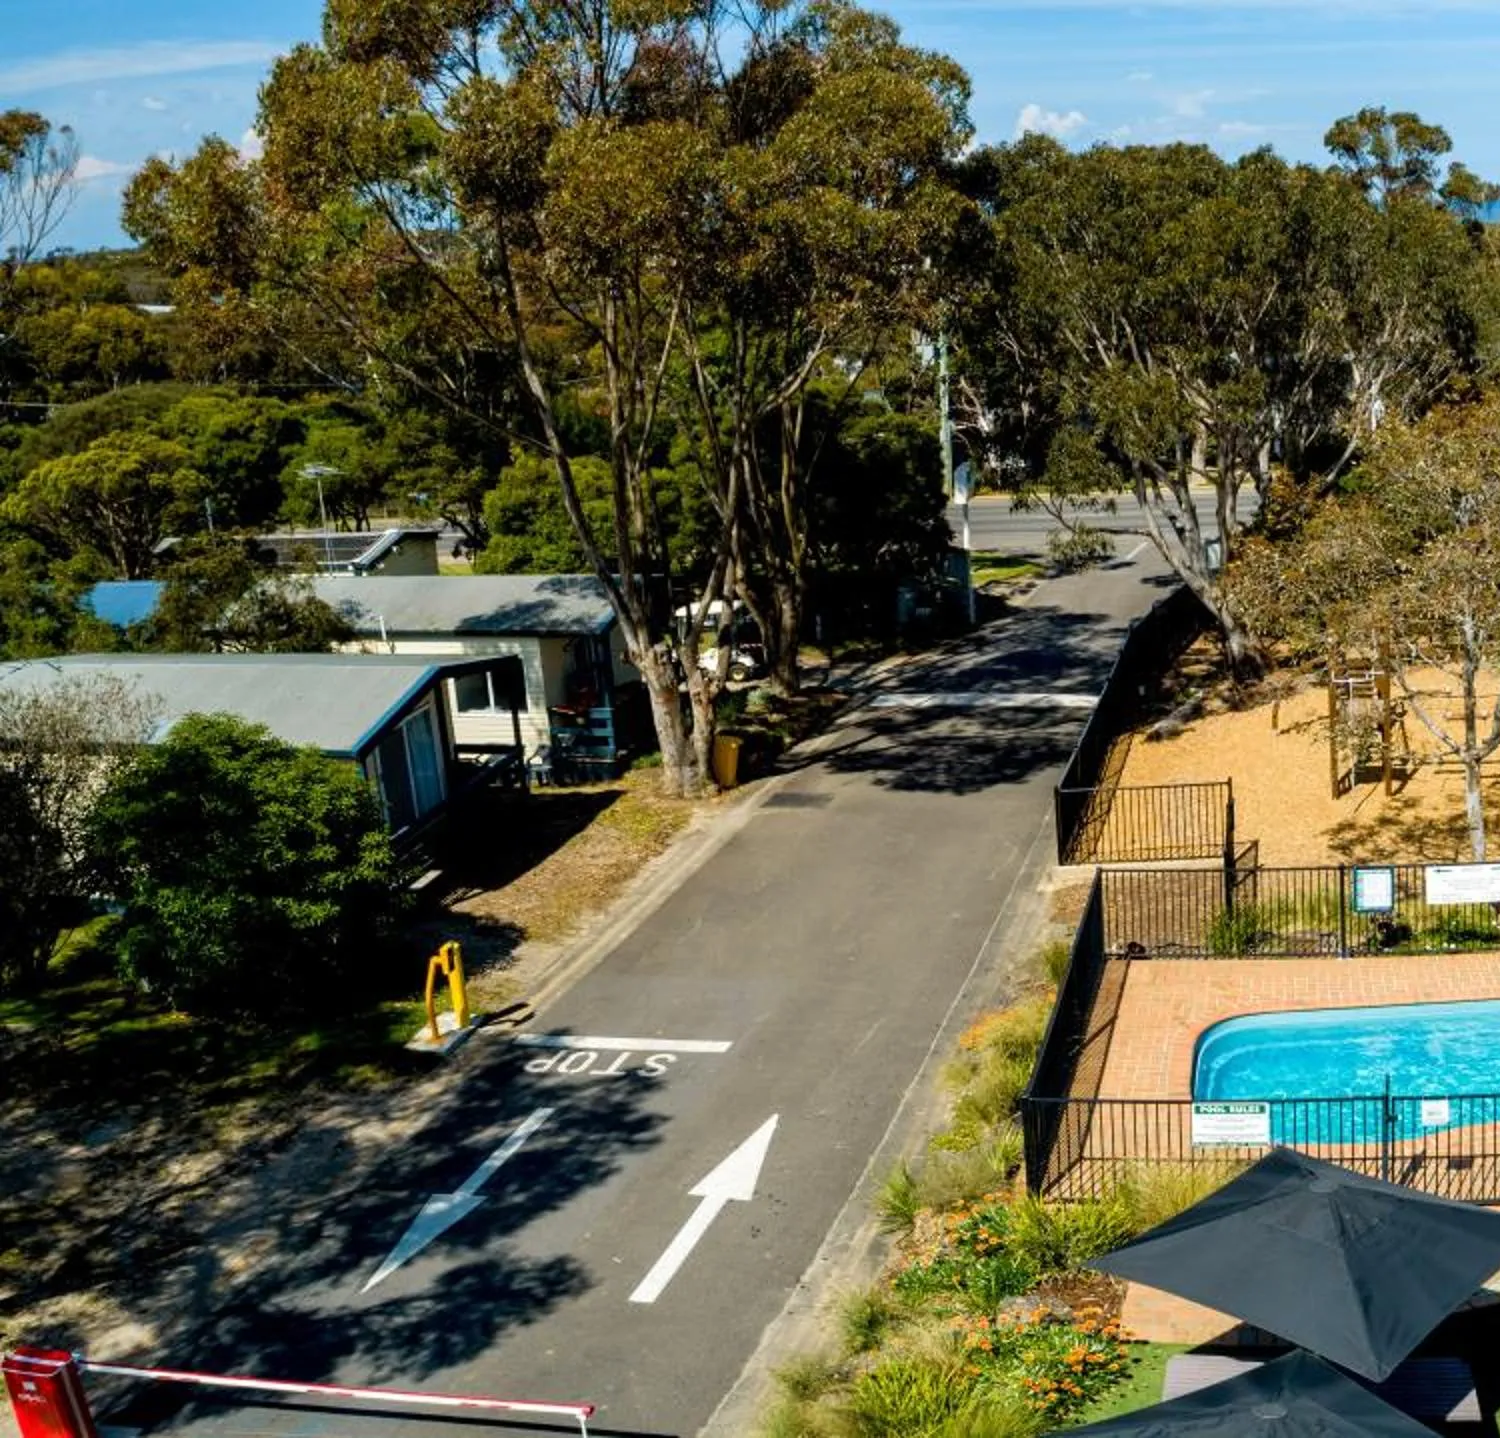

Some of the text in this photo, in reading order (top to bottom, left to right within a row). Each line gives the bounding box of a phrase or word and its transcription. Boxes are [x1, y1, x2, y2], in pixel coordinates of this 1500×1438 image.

[523, 1050, 678, 1077] STOP
[1199, 1104, 1260, 1113] POOL RULES
